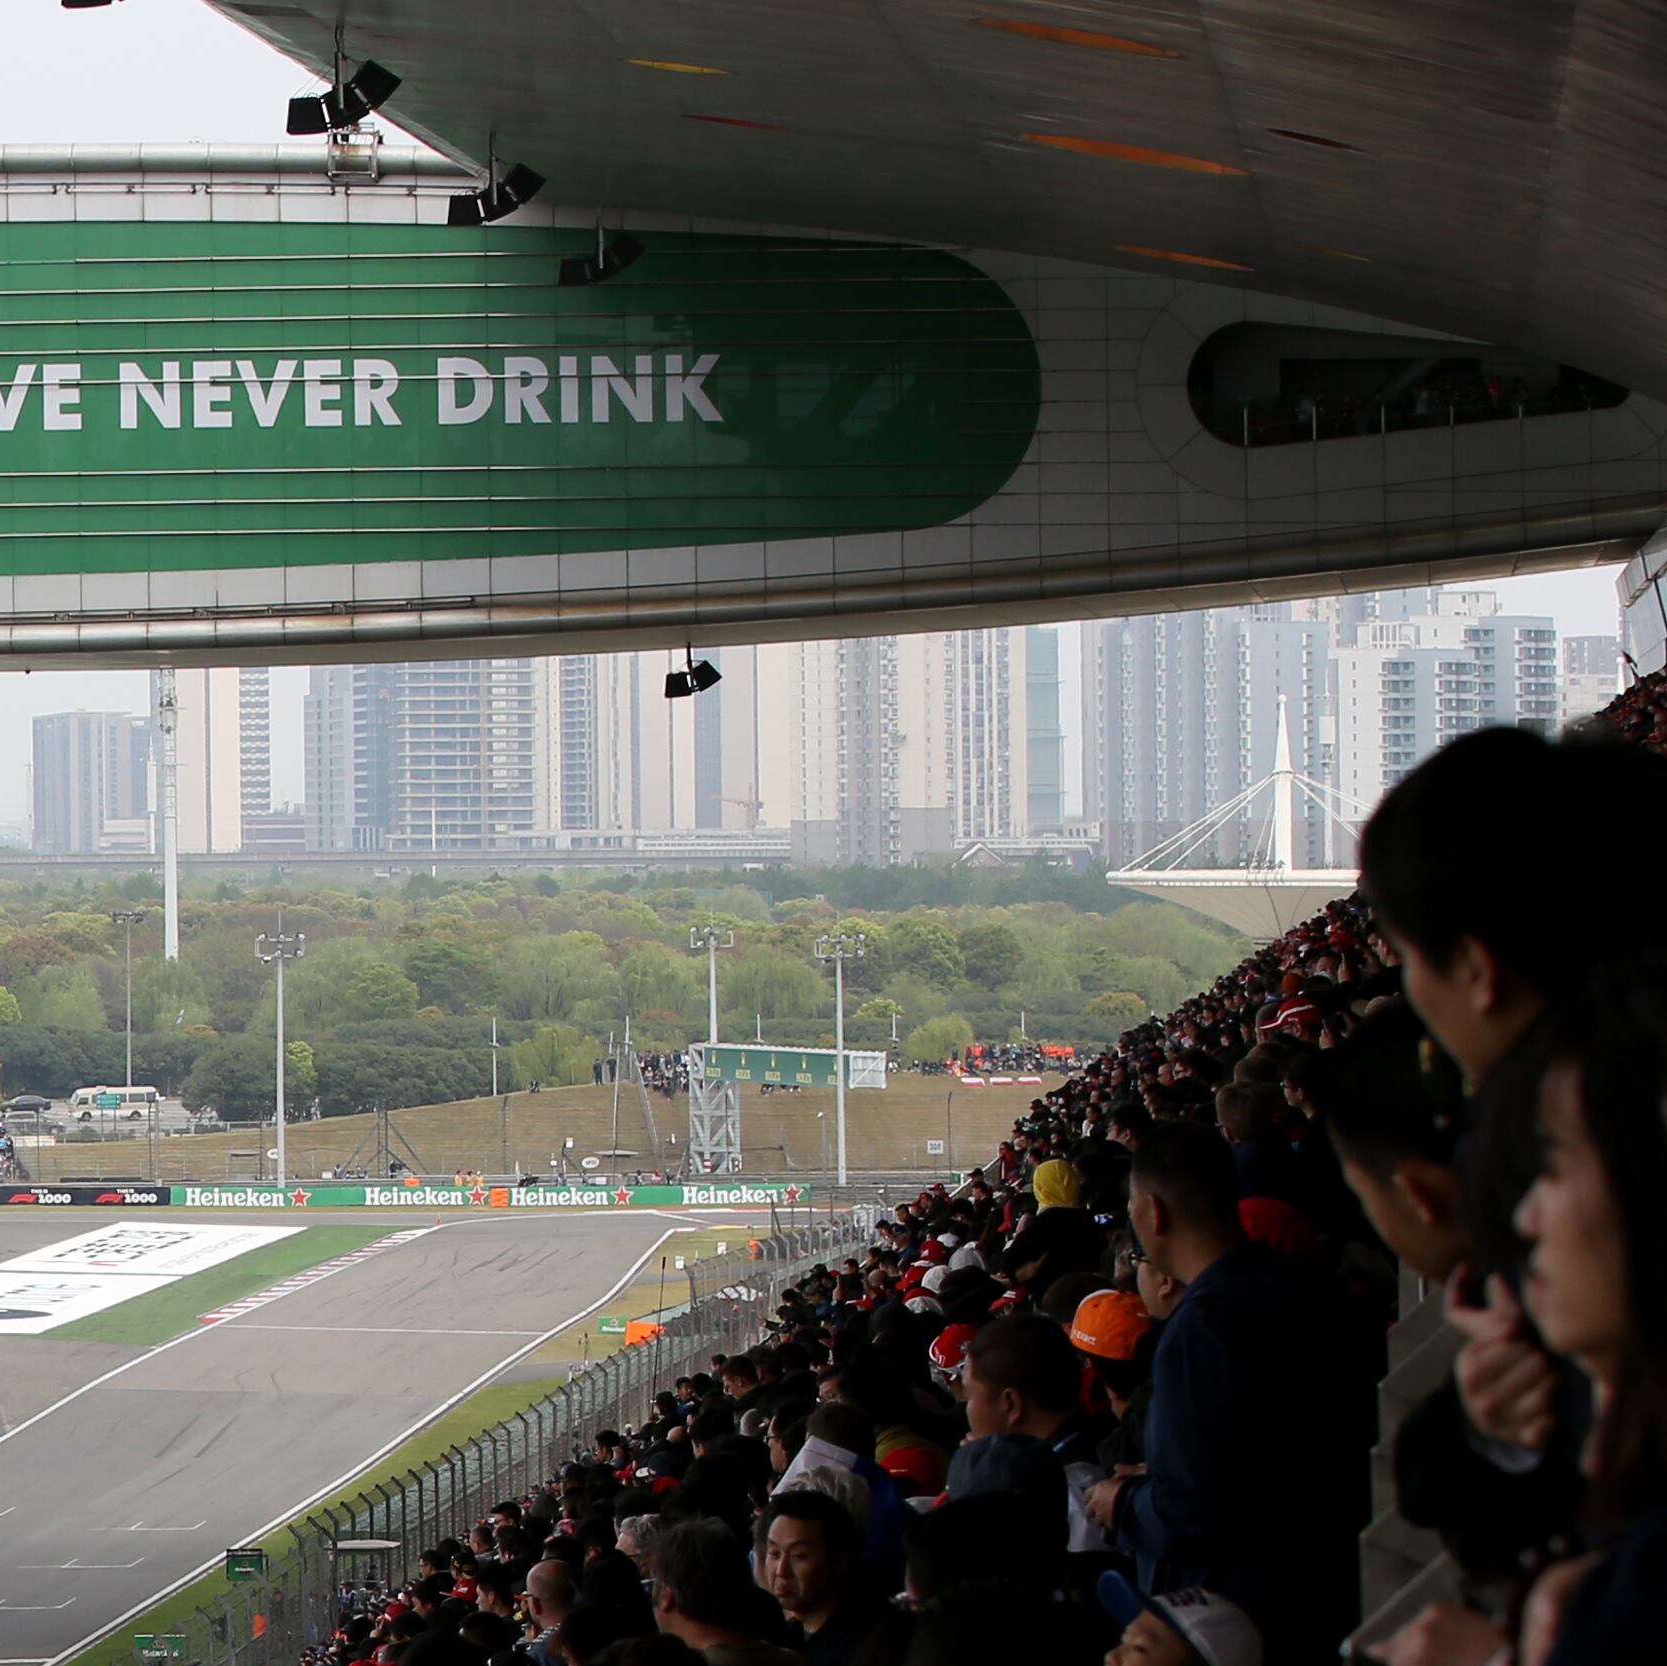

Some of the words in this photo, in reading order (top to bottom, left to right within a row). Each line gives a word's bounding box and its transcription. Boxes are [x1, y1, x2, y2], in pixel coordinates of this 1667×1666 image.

[120, 357, 401, 429] NEVER
[436, 353, 725, 425] DRINK
[38, 1193, 71, 1204] 1000
[124, 1193, 157, 1204] 1000
[185, 1187, 284, 1207] Heineken
[364, 1187, 463, 1206] Heineken
[510, 1187, 608, 1206] Heineken
[682, 1186, 779, 1205] Heineken
